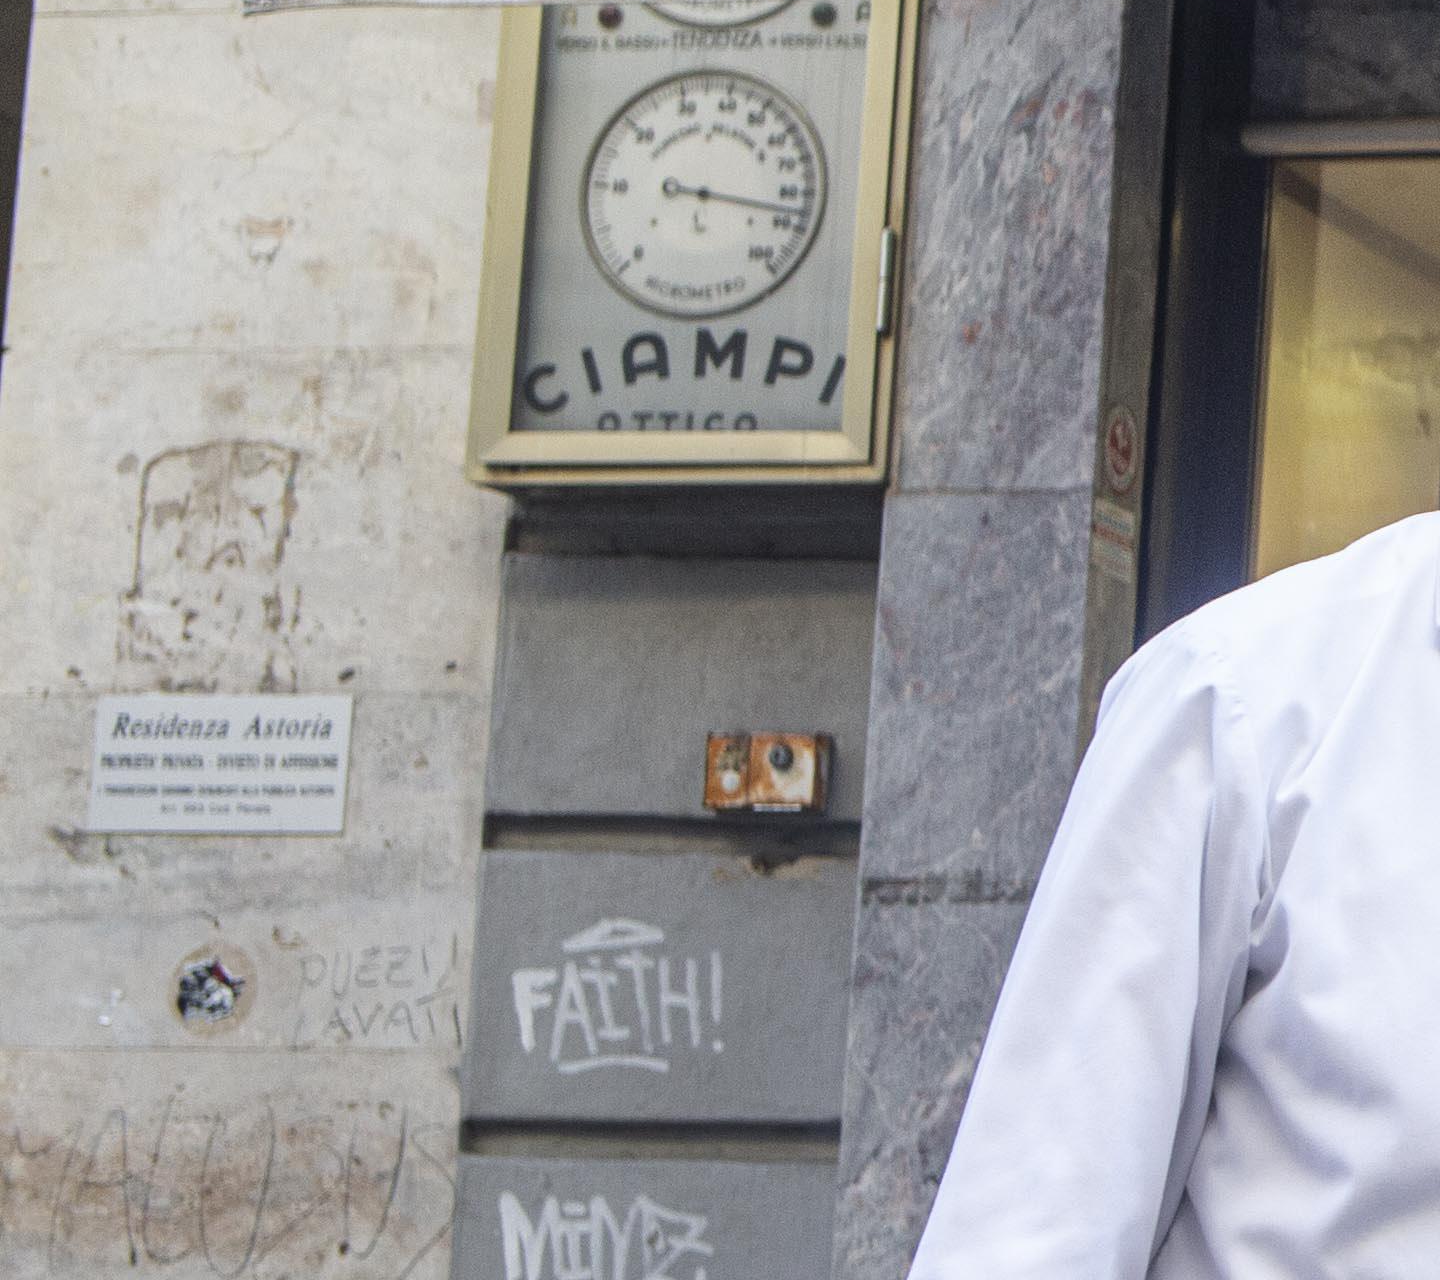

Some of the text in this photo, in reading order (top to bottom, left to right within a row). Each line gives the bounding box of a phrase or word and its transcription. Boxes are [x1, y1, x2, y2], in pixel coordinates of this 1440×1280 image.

[523, 326, 847, 414] CIAMPI
[243, 713, 332, 740] Astoria
[512, 948, 724, 1065] FAITH!
